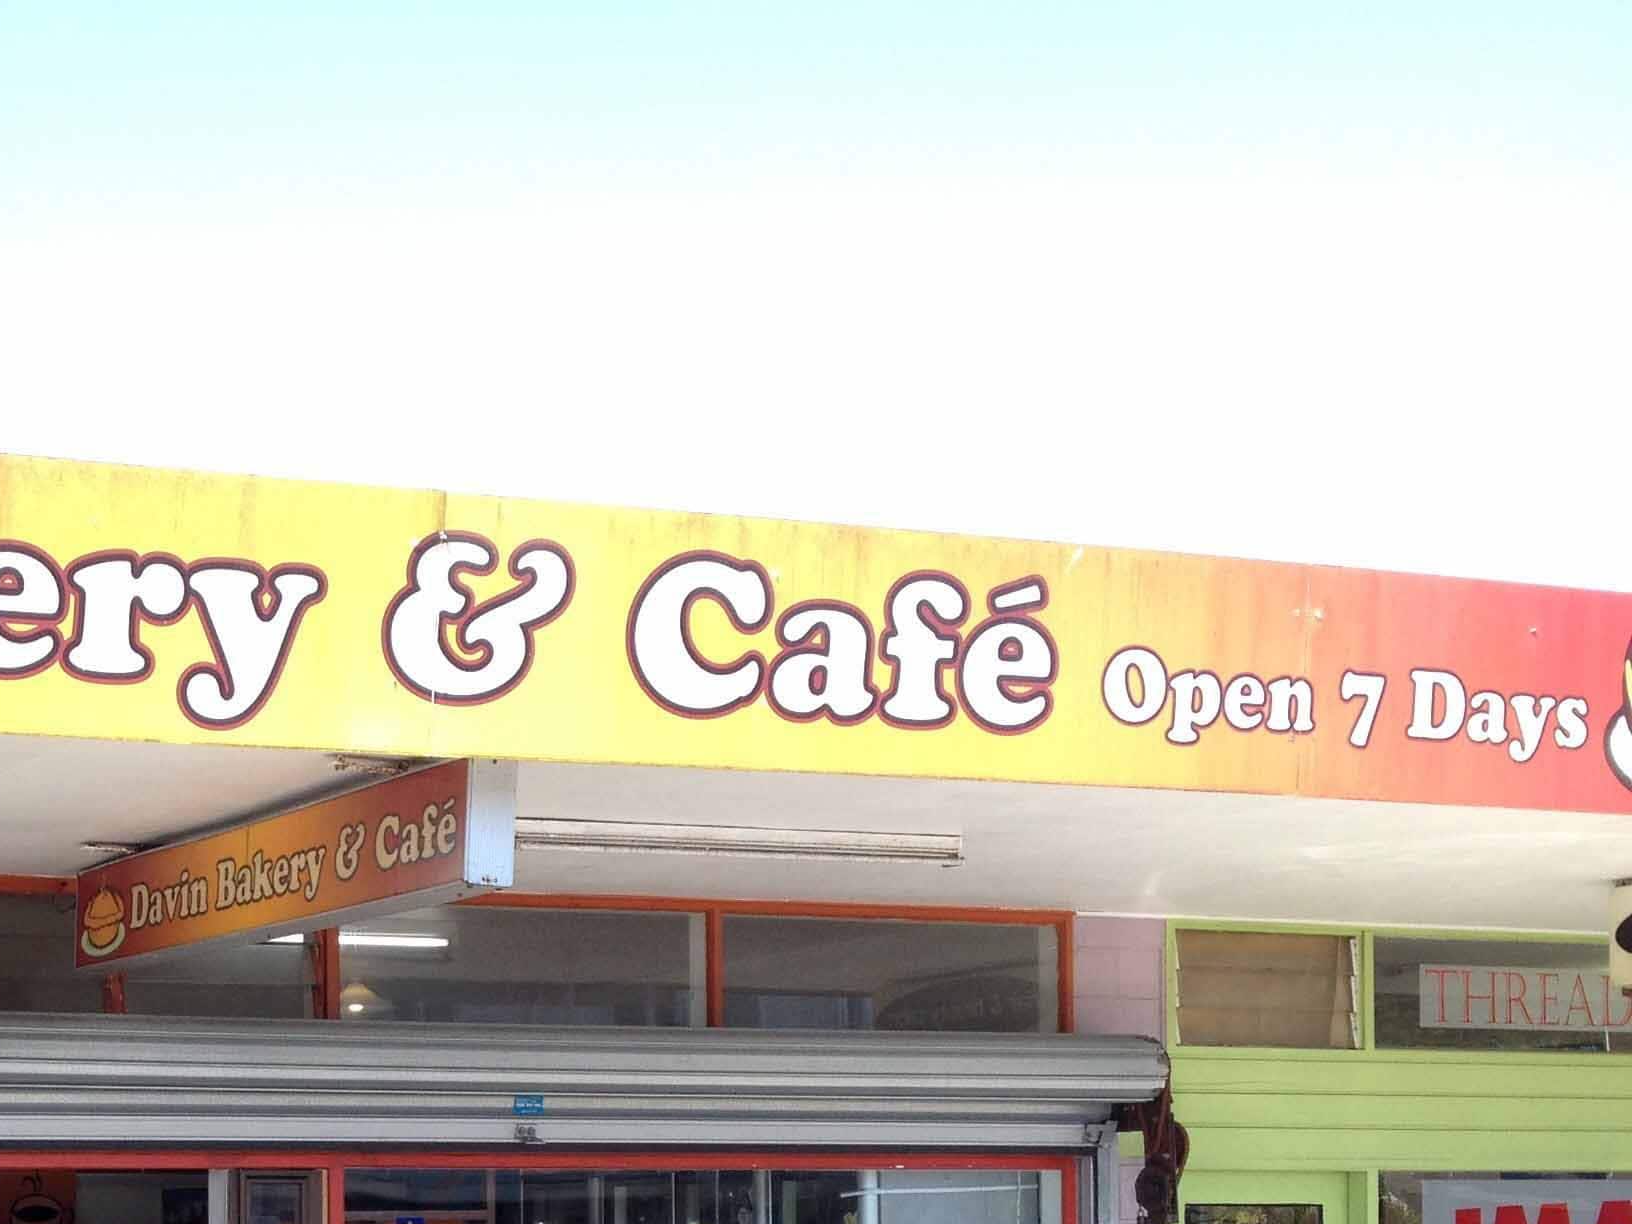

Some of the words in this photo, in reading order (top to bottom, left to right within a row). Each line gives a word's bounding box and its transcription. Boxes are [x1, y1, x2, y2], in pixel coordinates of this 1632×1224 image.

[382, 531, 575, 705] &
[628, 551, 1058, 735] Café
[1102, 646, 1314, 745] Open
[1340, 669, 1385, 748] 7
[1405, 667, 1589, 762] Days
[130, 869, 209, 929] Davin
[215, 846, 327, 911] Bakery
[335, 822, 365, 880] &
[375, 798, 457, 870] Café
